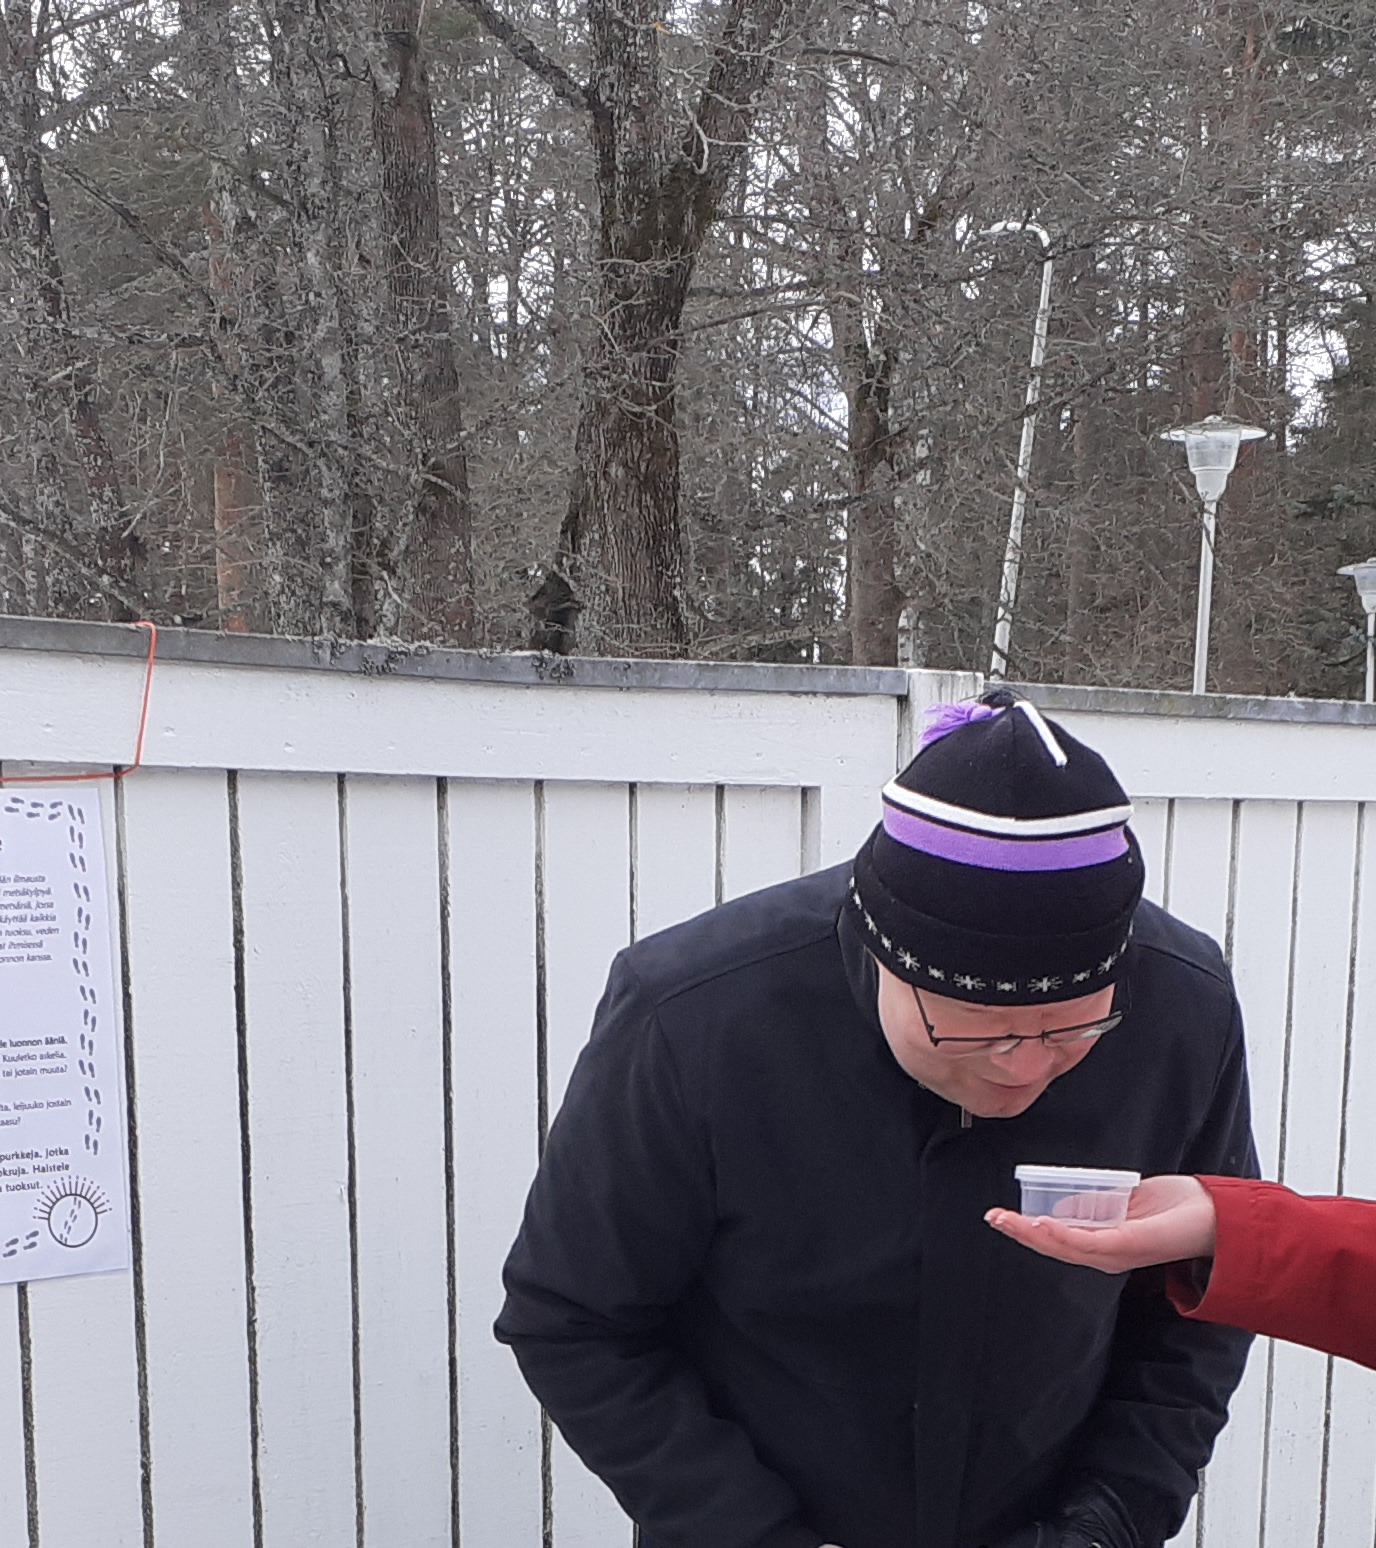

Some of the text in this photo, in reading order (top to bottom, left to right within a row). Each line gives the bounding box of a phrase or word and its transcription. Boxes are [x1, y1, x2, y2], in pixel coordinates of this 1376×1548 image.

[45, 1146, 69, 1159] jotka
[32, 1161, 69, 1173] Haistele
[5, 1180, 42, 1194] tuoksut.
